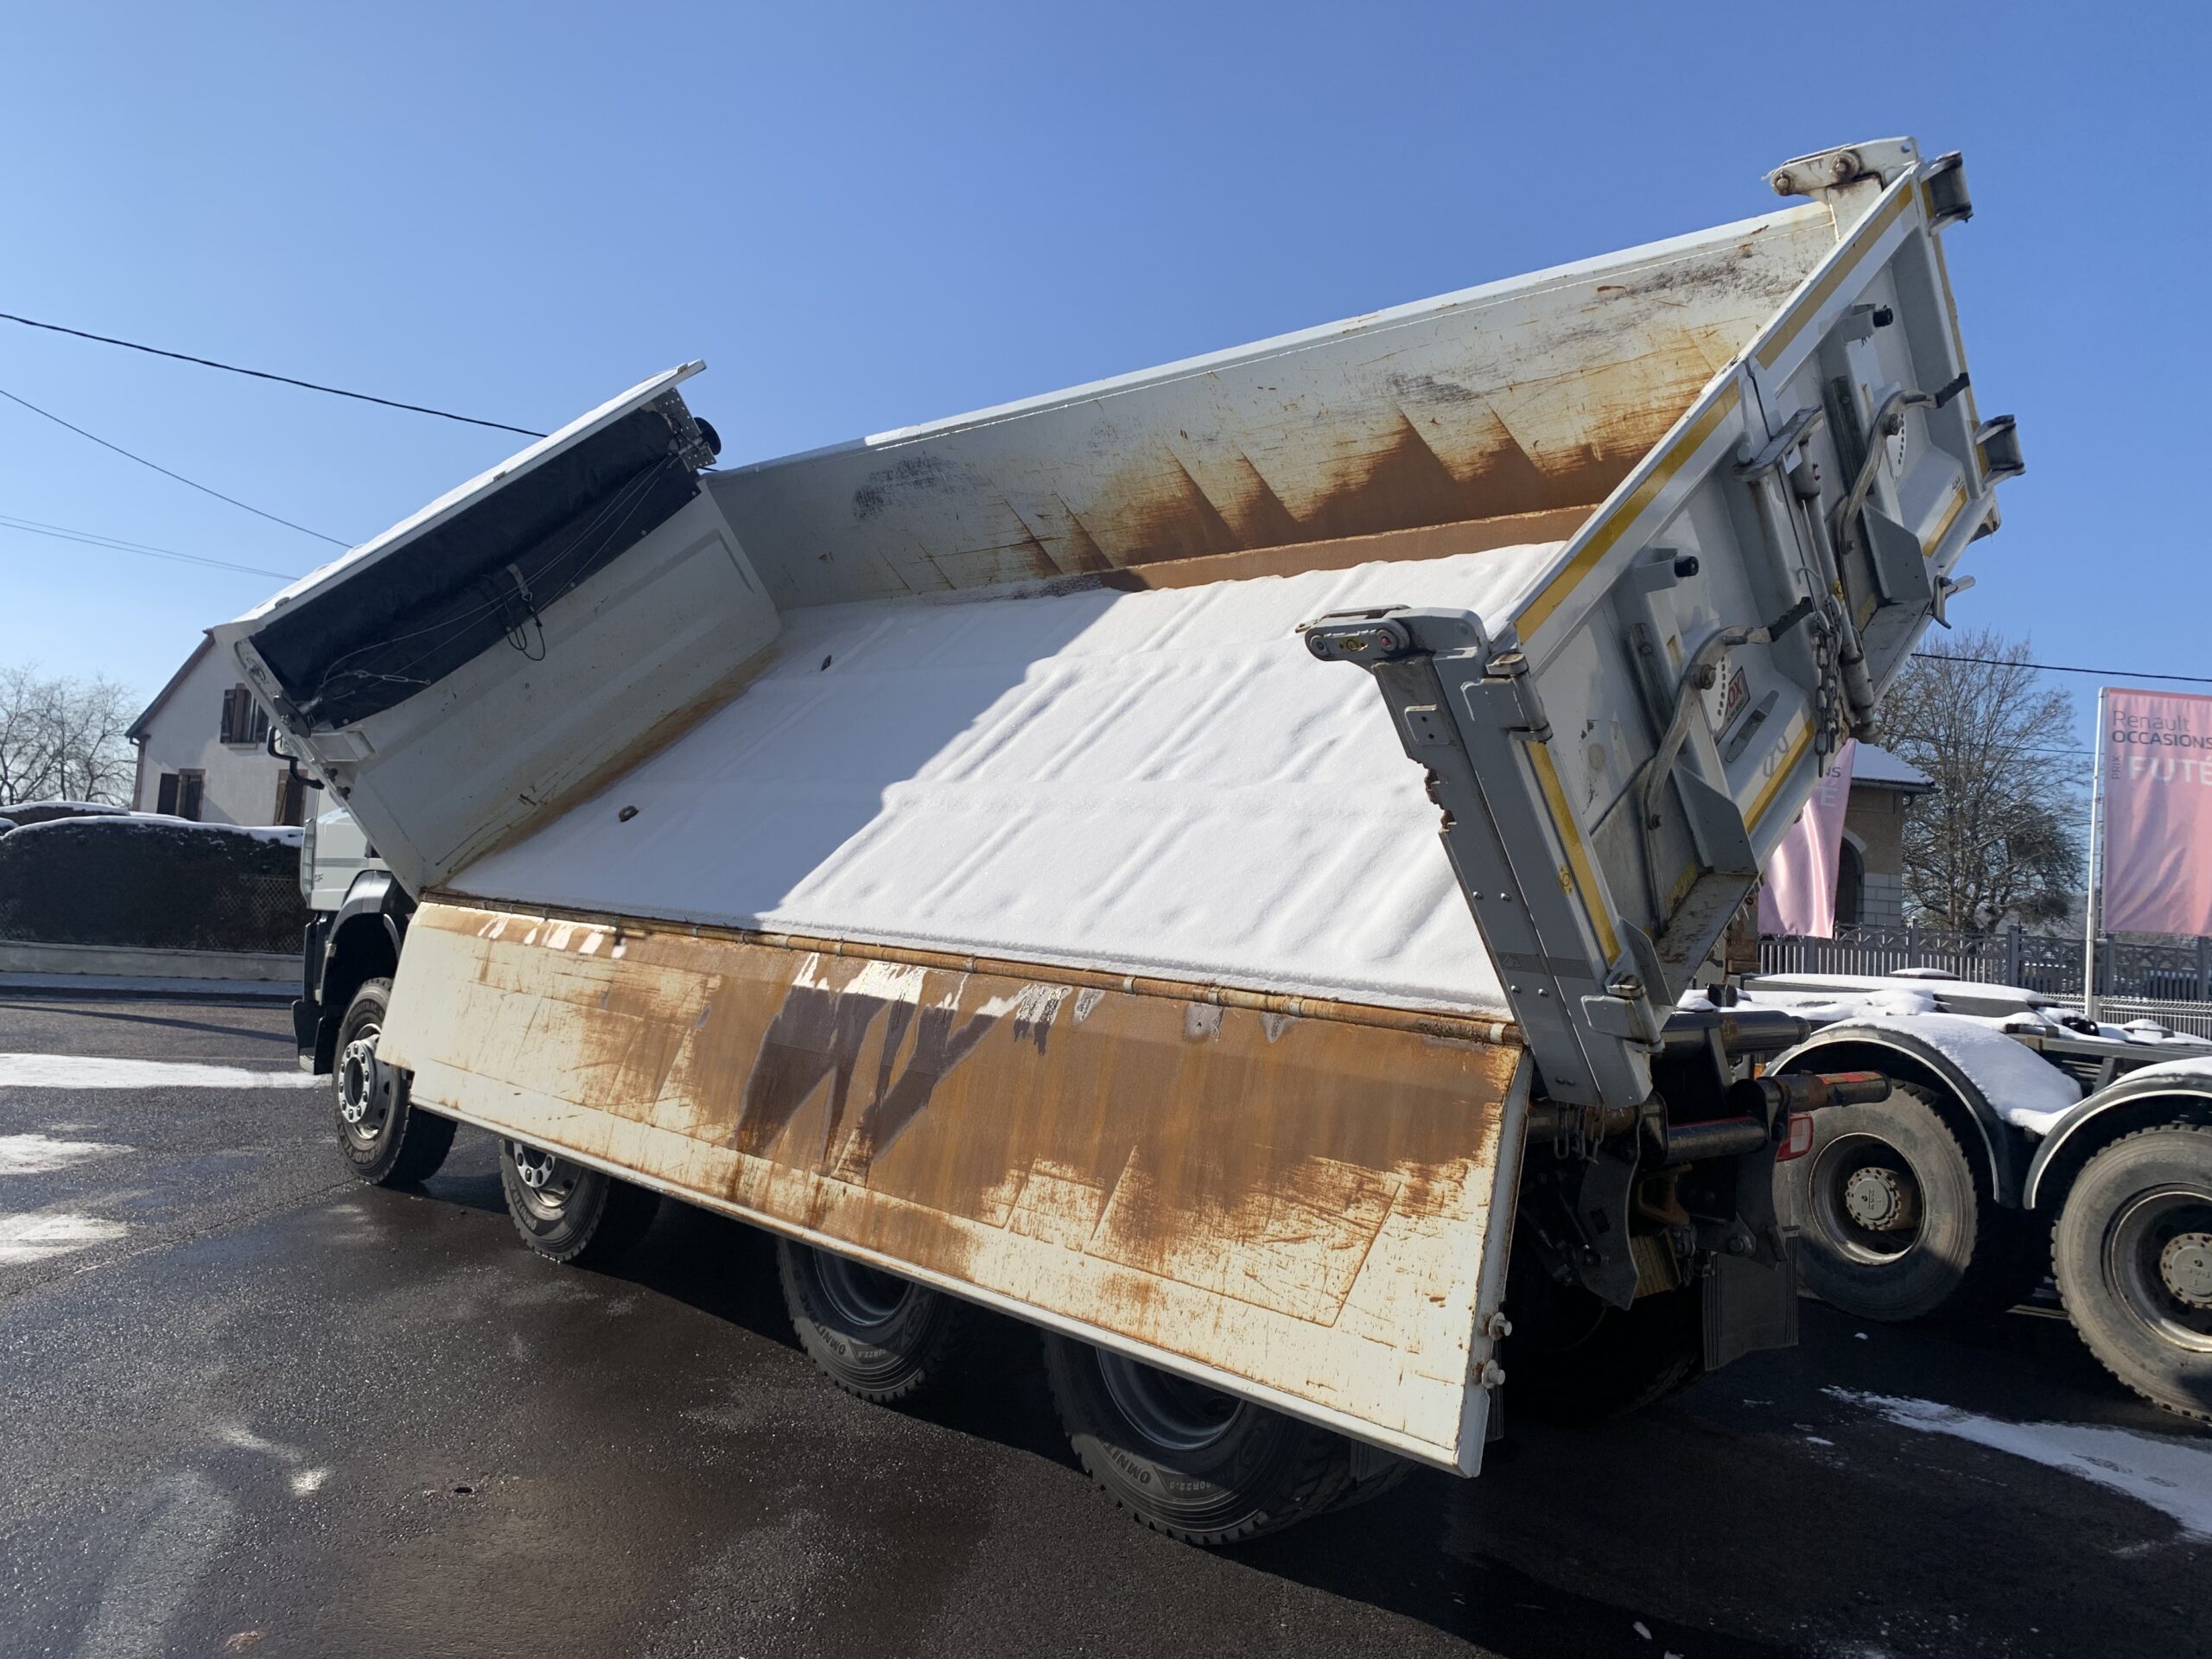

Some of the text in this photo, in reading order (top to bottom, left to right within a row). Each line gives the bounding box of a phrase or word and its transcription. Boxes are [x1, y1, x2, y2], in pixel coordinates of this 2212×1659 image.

[2113, 710, 2190, 732] Renault
[2112, 730, 2212, 750] OCCASIONS
[2111, 755, 2121, 779] PRIX
